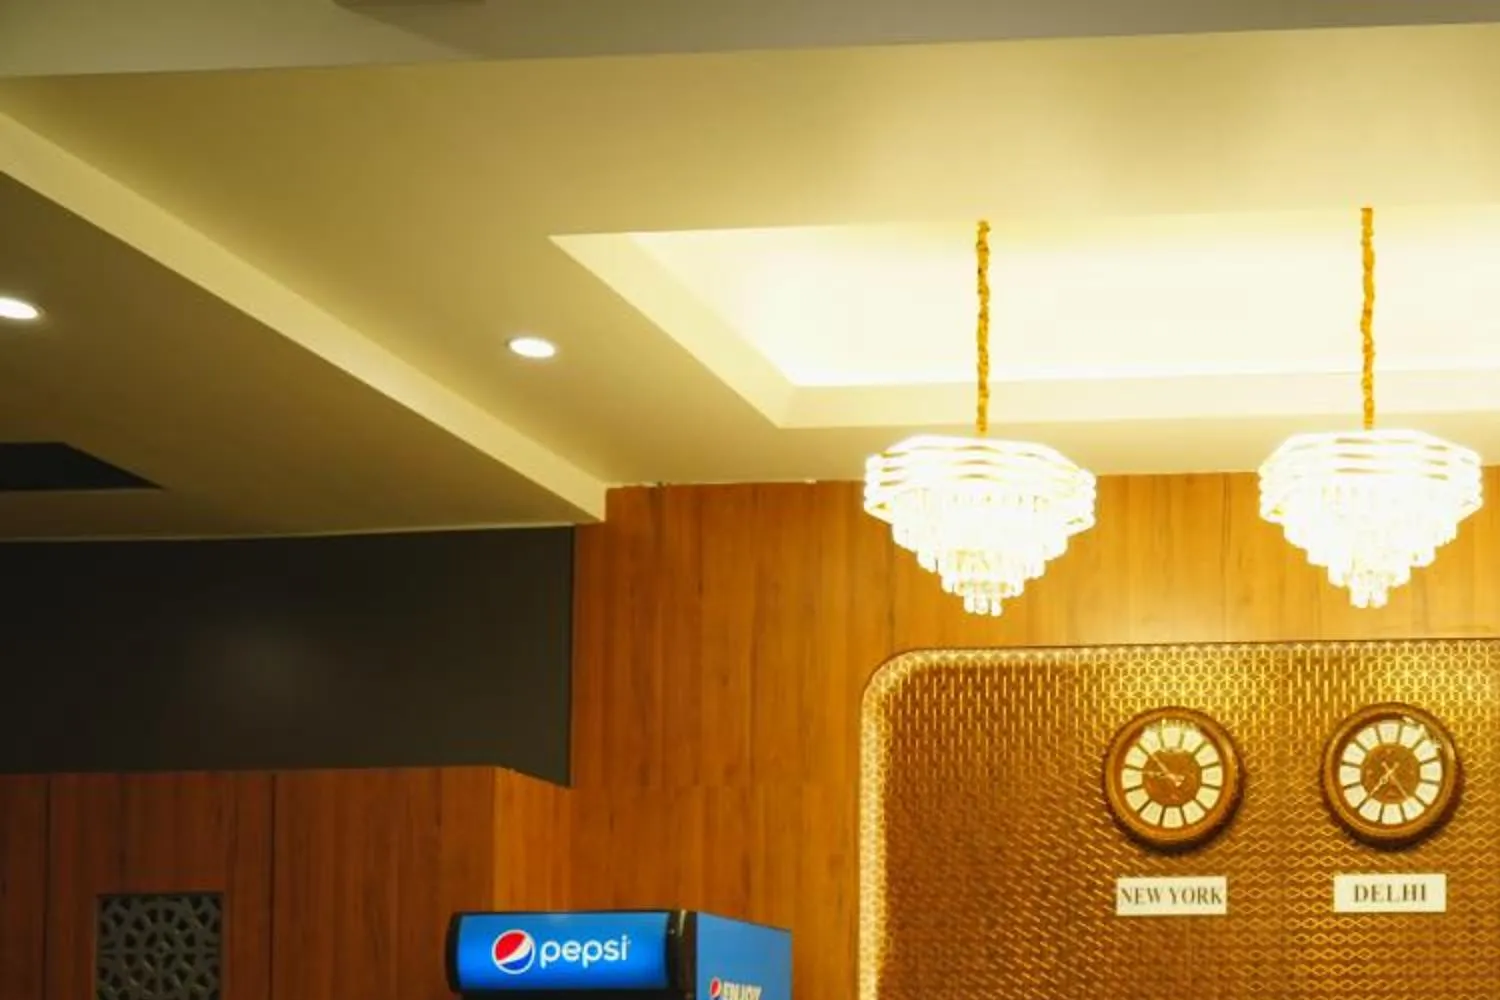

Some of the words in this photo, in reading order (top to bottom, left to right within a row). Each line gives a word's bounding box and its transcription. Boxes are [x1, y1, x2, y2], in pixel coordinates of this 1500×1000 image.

[1120, 887, 1161, 905] NEW
[1168, 886, 1223, 905] YORK
[1353, 882, 1428, 903] DELHI
[540, 934, 629, 968] pepsi
